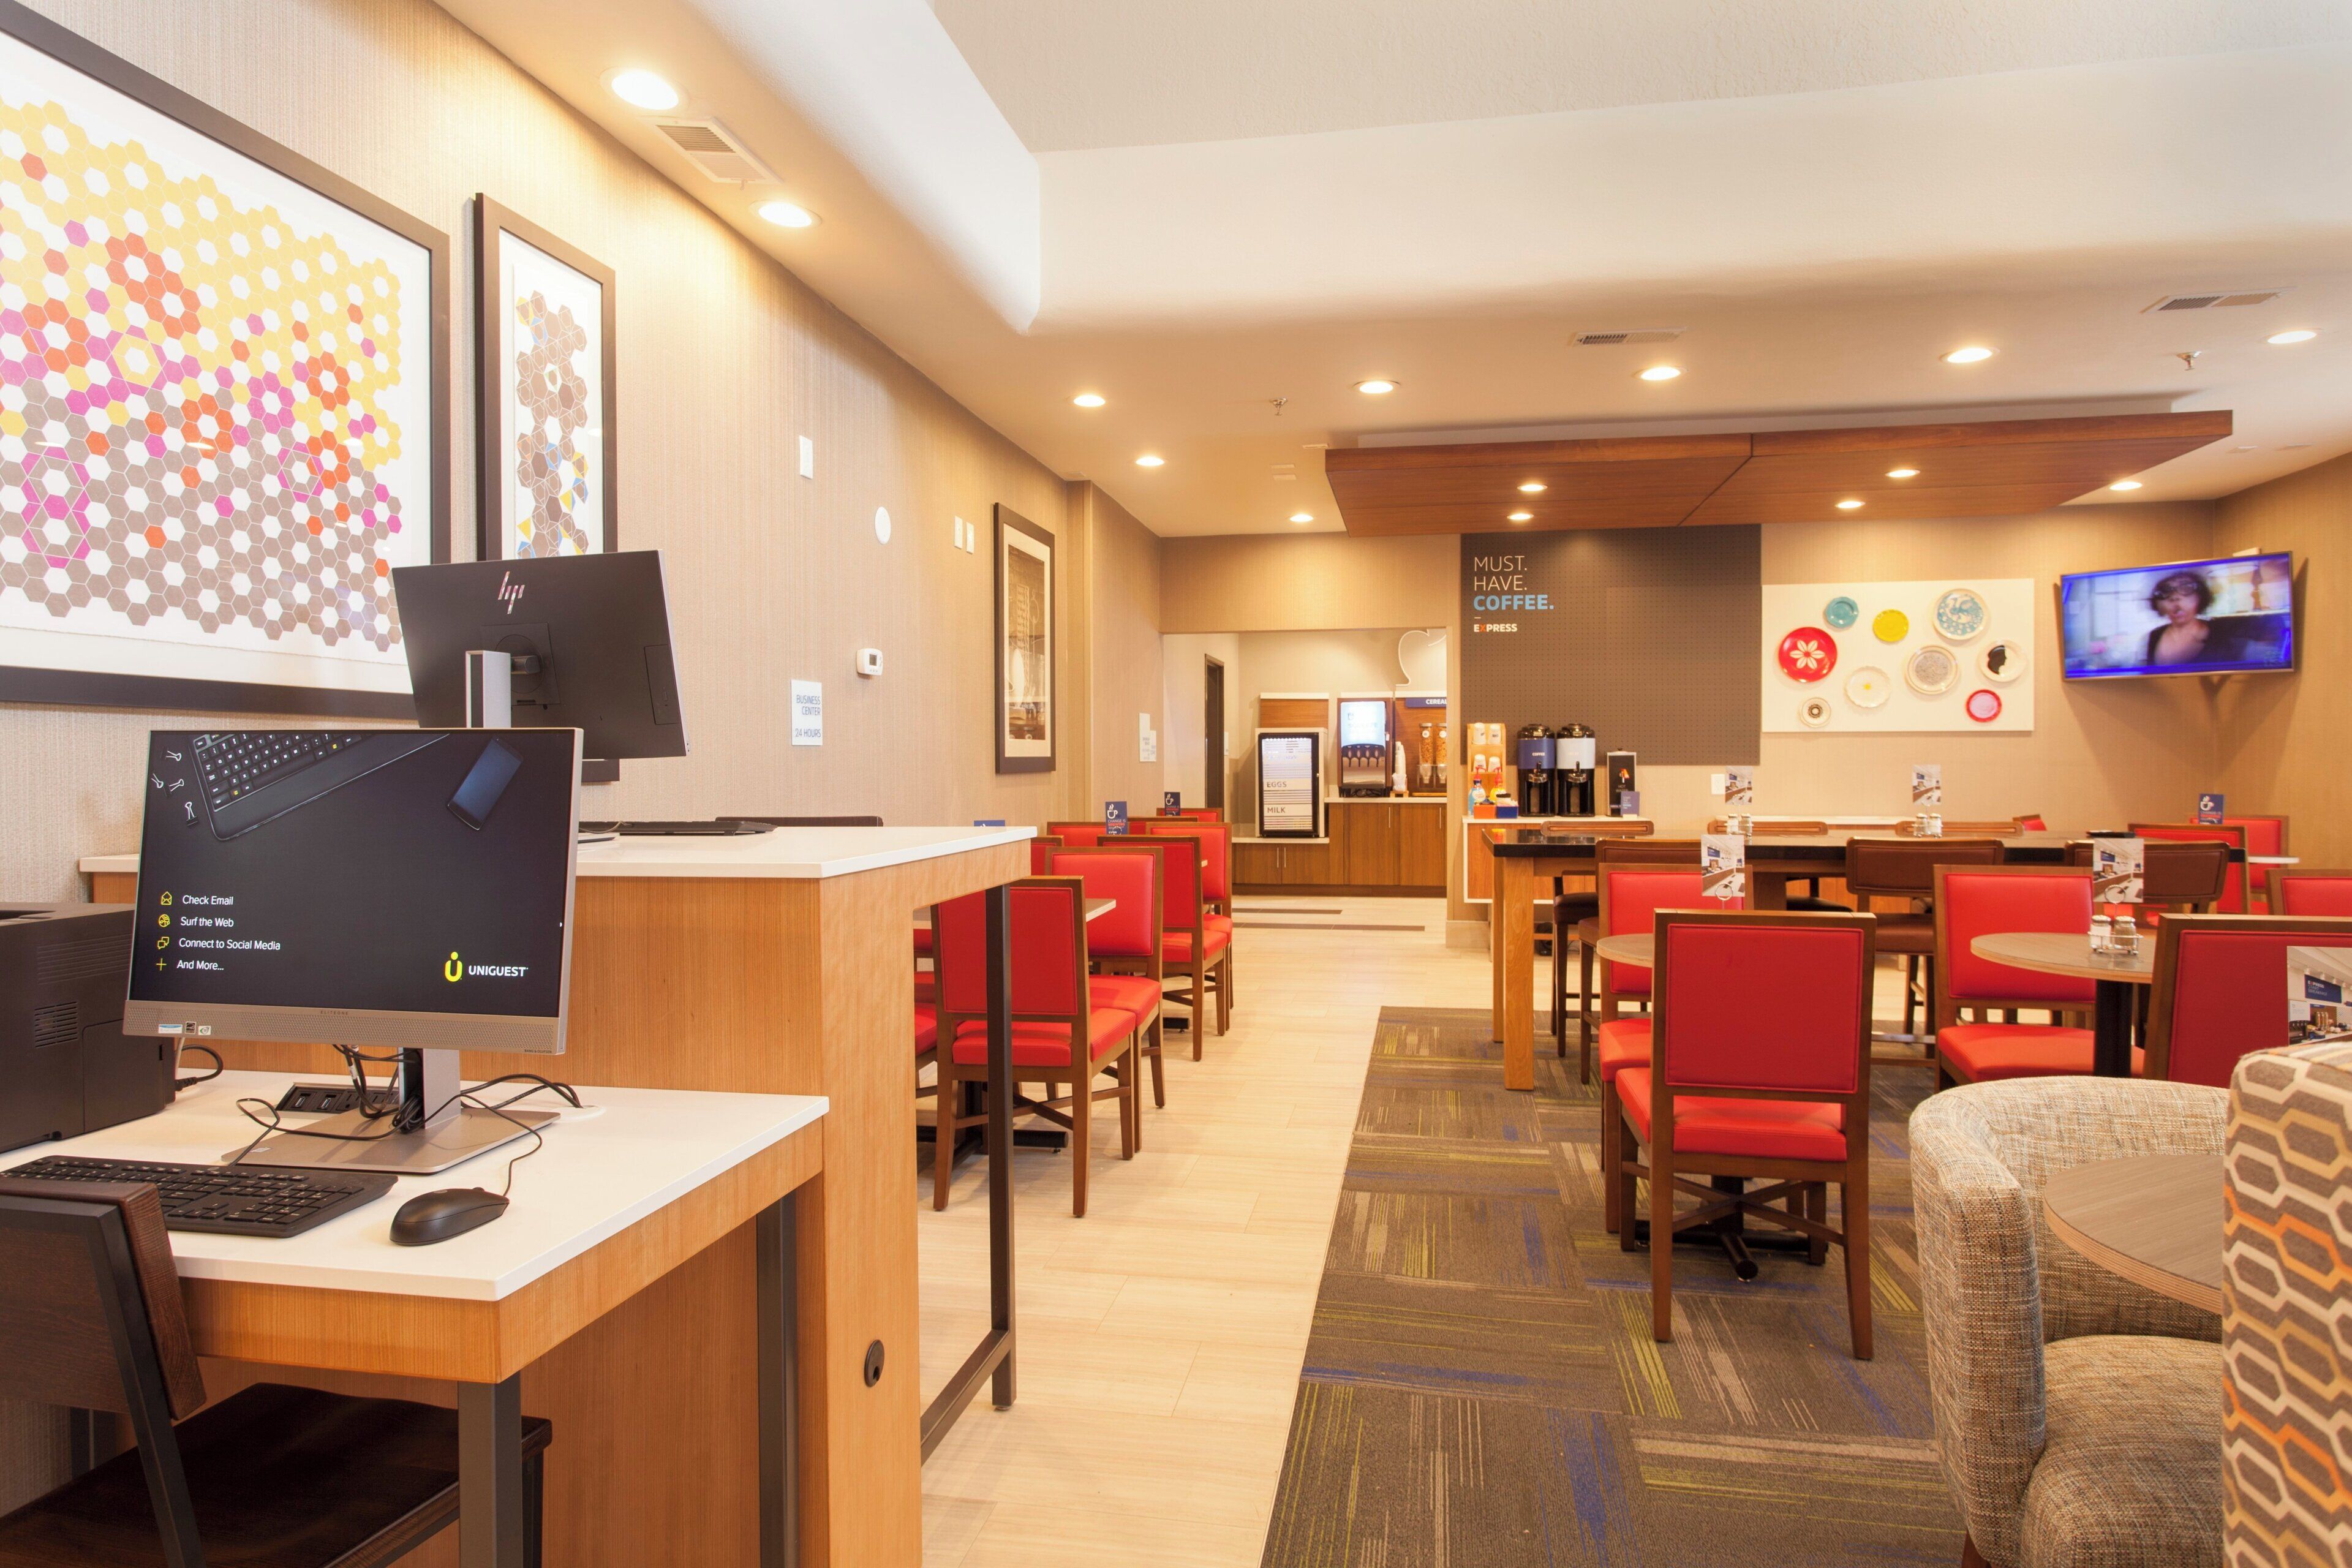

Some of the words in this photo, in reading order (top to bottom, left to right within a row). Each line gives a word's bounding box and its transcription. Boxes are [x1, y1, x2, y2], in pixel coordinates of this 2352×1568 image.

[1474, 556, 1527, 571] MUST.
[1474, 575, 1527, 591] HAVE.
[1474, 595, 1554, 611] COFFEE.
[1474, 624, 1518, 632] EXPRESS
[796, 695, 821, 705] BUSINESS
[801, 706, 821, 715] CENTER
[795, 728, 802, 737] 24
[804, 729, 821, 737] HOURS
[183, 895, 209, 905] Check
[211, 896, 233, 905] Email
[180, 916, 198, 926] Surf
[199, 918, 213, 927] the
[215, 918, 234, 927] Web
[179, 938, 214, 948] Connect
[227, 940, 252, 949] Social
[254, 940, 281, 950] Media
[177, 960, 194, 969] And
[196, 960, 224, 970] More...
[468, 965, 527, 977] UNIGUEST
